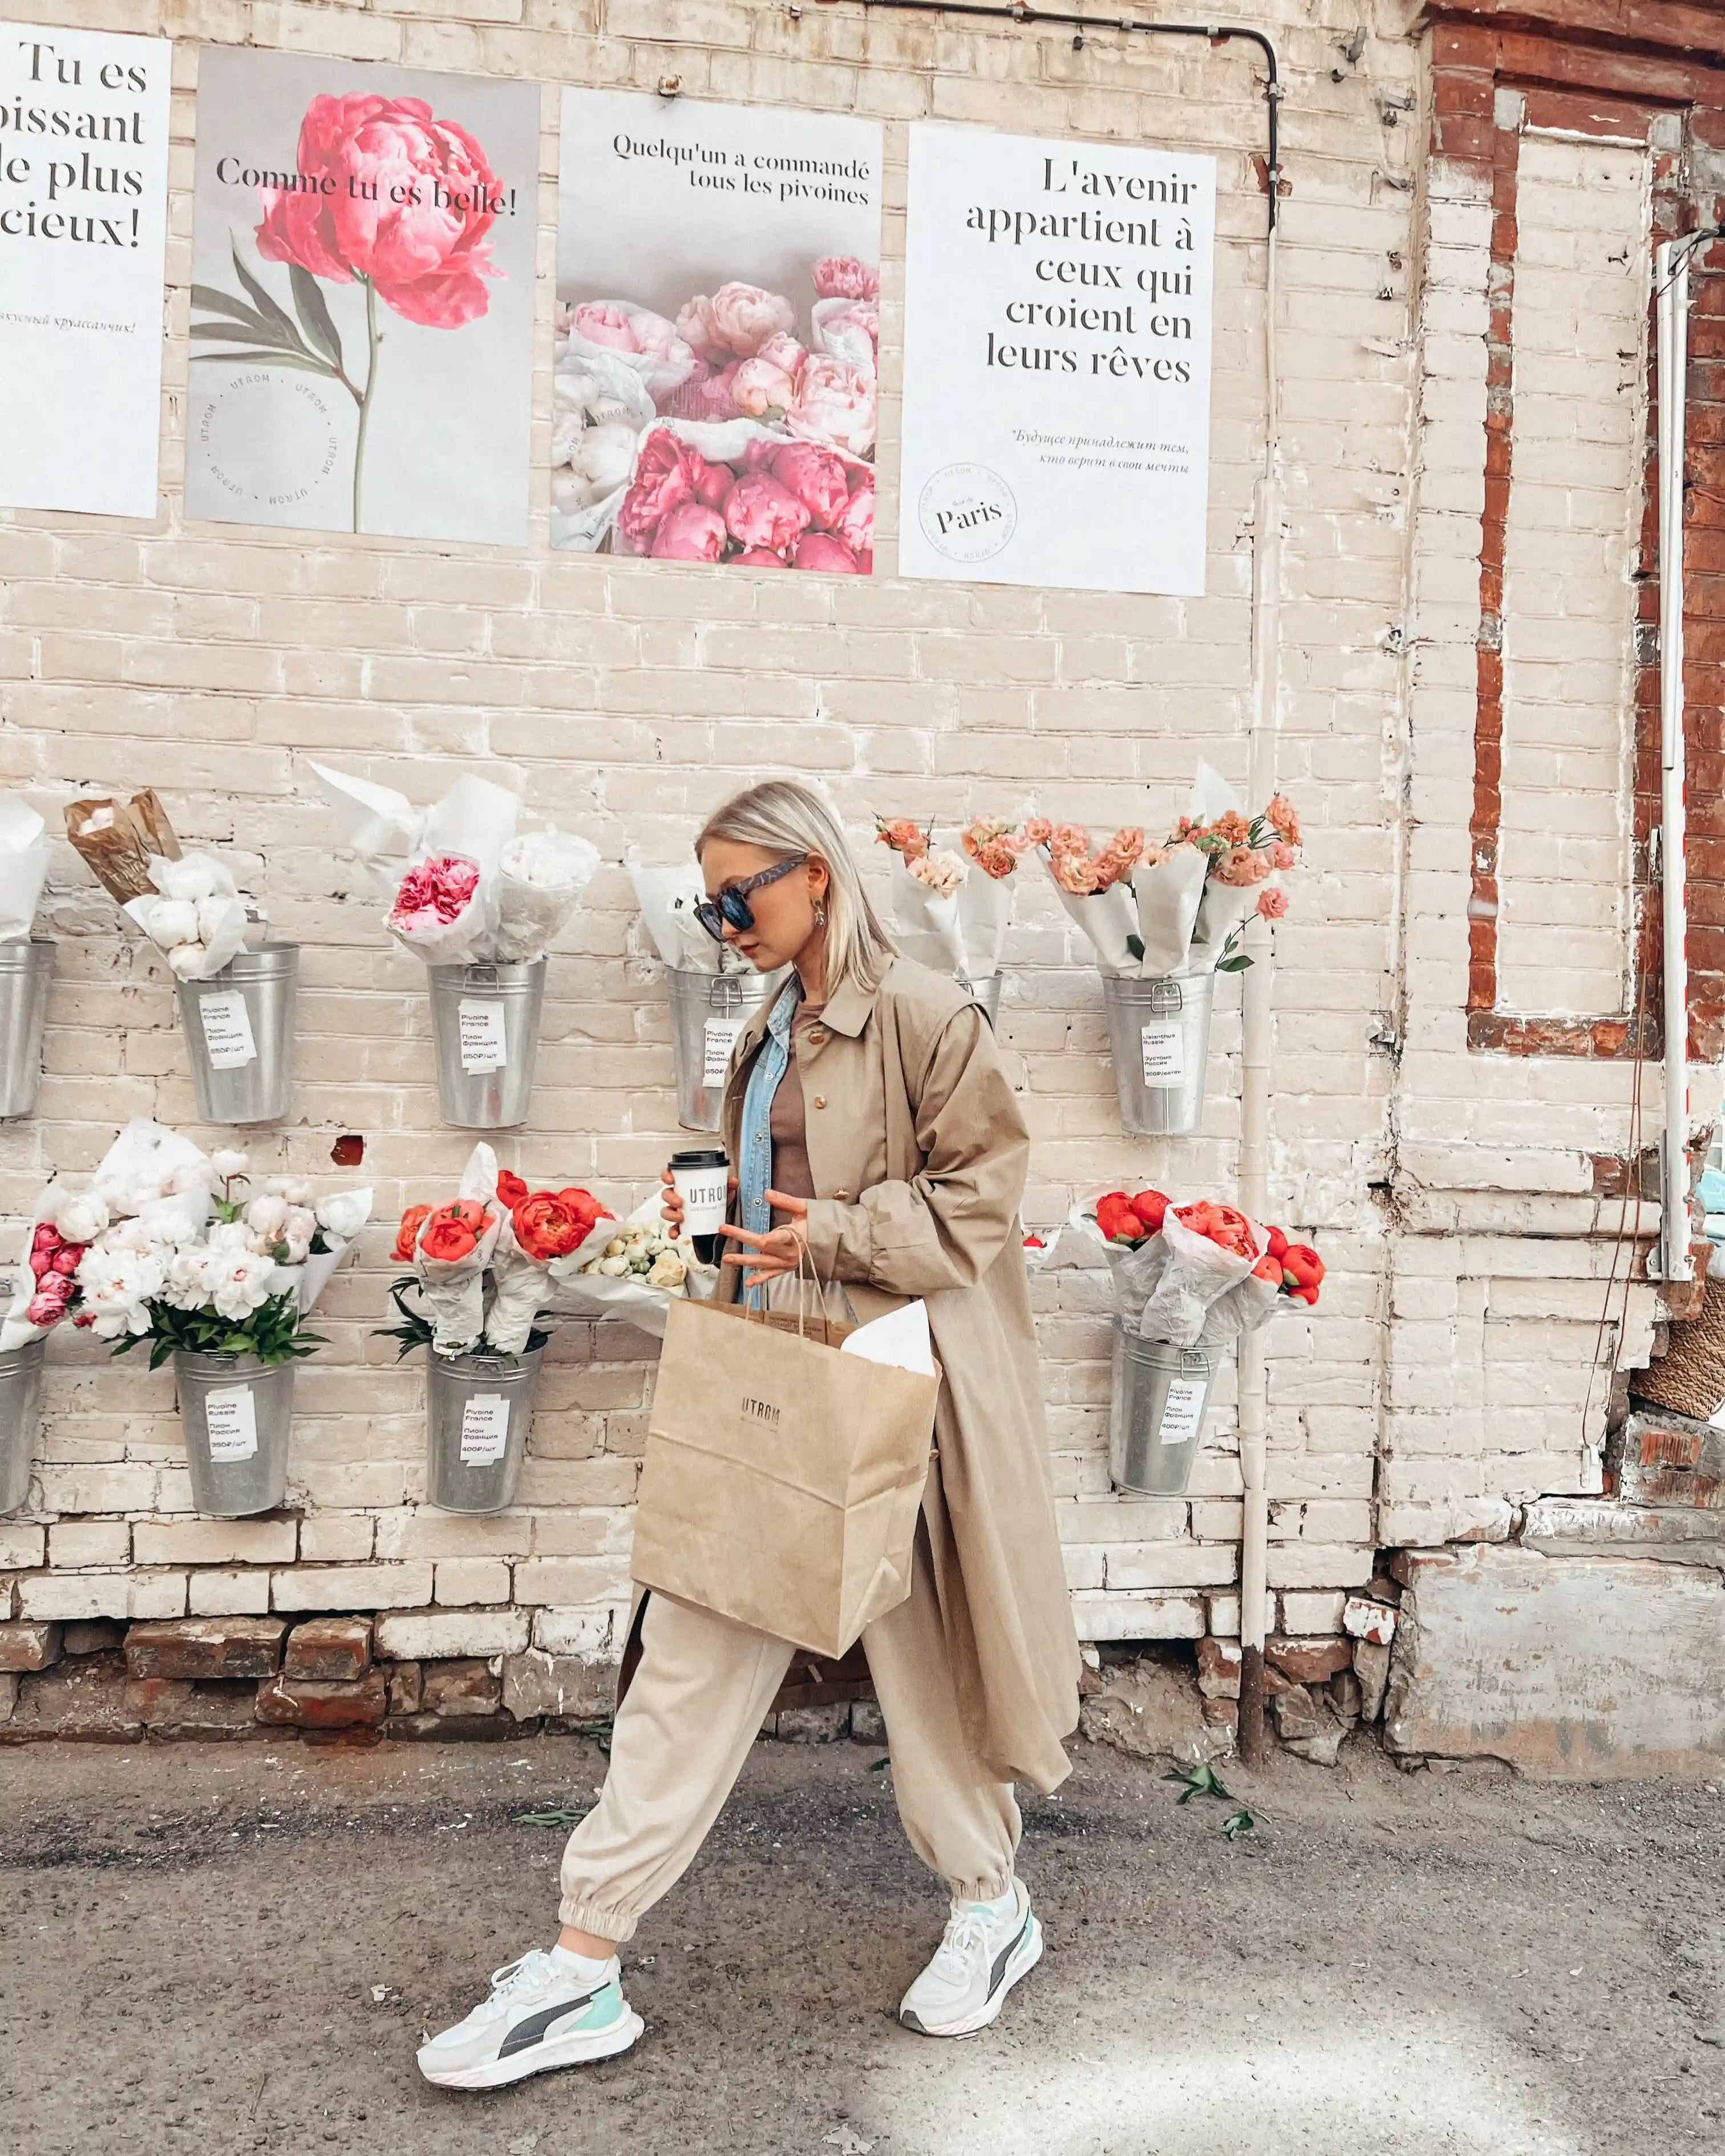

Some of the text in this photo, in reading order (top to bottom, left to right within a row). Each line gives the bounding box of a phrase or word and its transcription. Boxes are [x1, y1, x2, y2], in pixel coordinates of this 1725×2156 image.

[19, 42, 147, 93] Tu es
[0, 143, 143, 200] e plus
[613, 133, 870, 181] Quelqu'un a commandé
[216, 157, 516, 216] Comme tu es belle!
[690, 170, 869, 206] tous les pivoines
[1042, 157, 1197, 205] L'avenir
[0, 201, 139, 248] cieux!
[966, 205, 1195, 251] appartient à
[1036, 259, 1192, 303] ceux qui
[1006, 298, 1192, 339] croient en
[986, 333, 1191, 383] leurs rêves
[230, 374, 270, 390] UTROM
[295, 383, 327, 414] UTROM
[201, 404, 216, 442] UTROM
[1068, 435, 1156, 451] принадлежит
[1039, 454, 1066, 464] кто
[1068, 456, 1106, 469] верит
[1118, 461, 1143, 470] свои
[1145, 463, 1189, 473] мечты
[269, 488, 308, 505] UTROM
[936, 501, 1002, 534] Paris
[742, 1397, 780, 1426] UTROM
